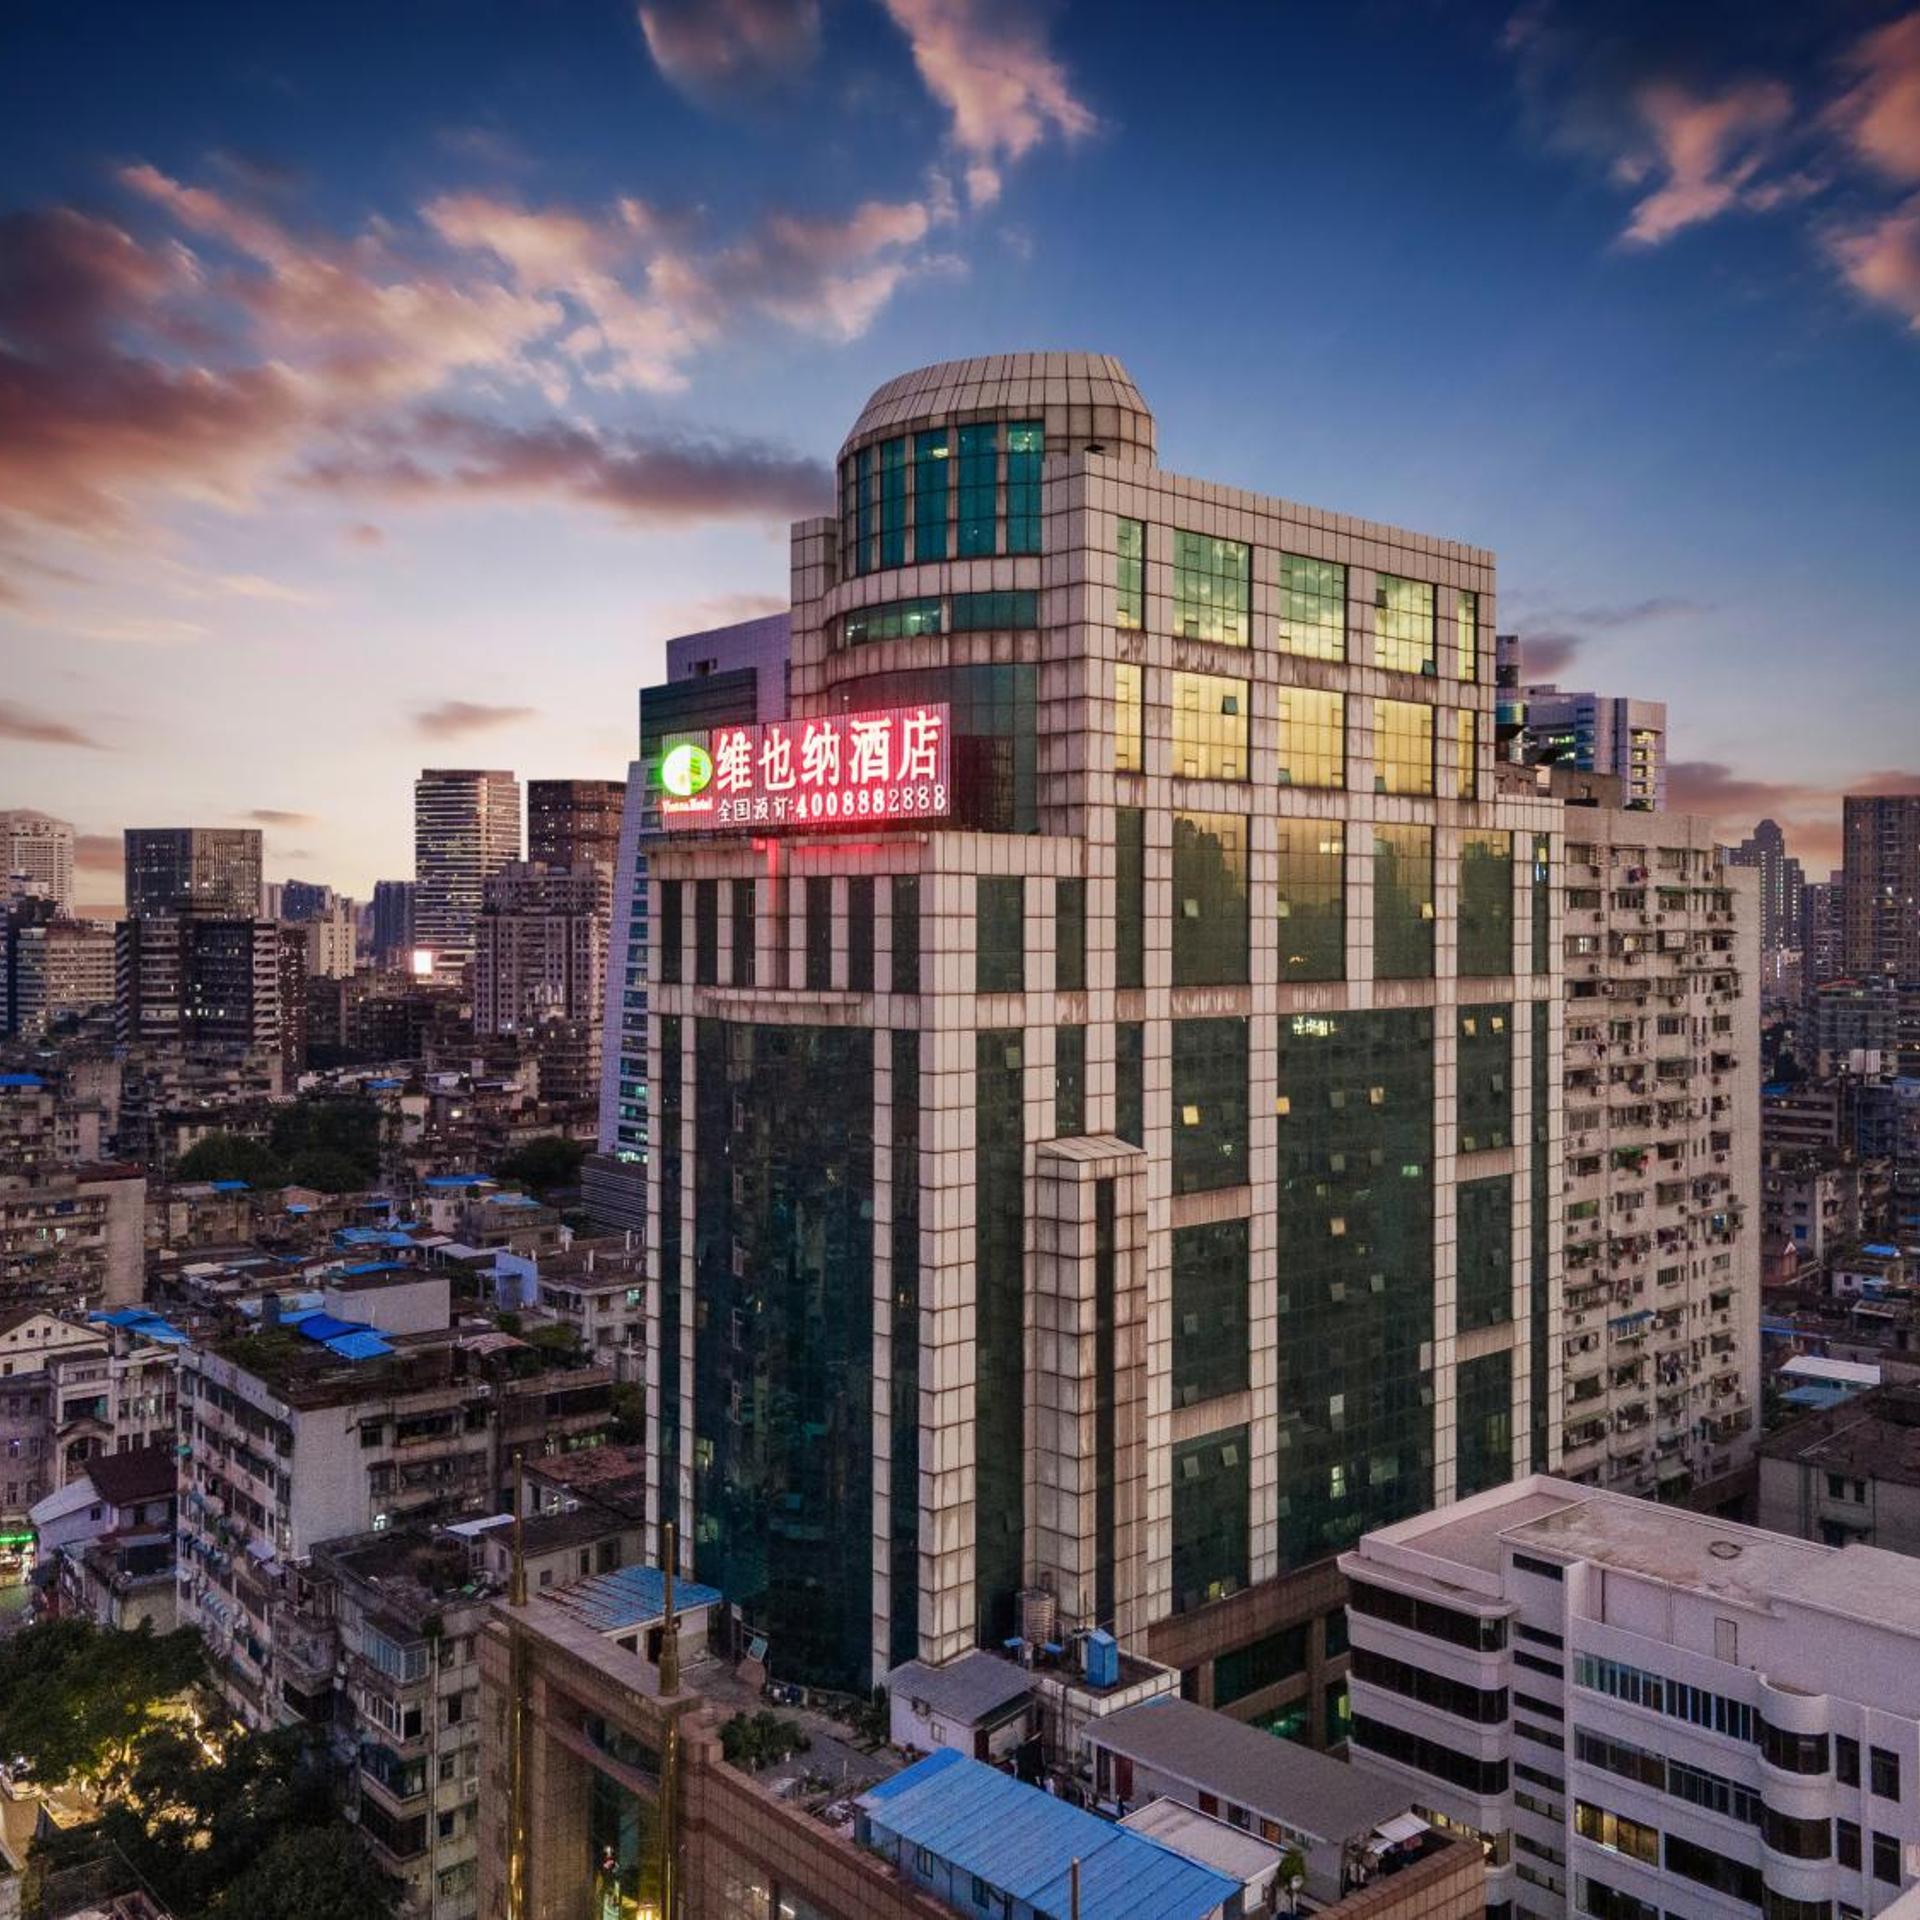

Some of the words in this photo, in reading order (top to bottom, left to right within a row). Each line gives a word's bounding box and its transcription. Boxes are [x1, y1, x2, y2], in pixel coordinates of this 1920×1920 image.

[716, 711, 943, 794] 维也纳酒店
